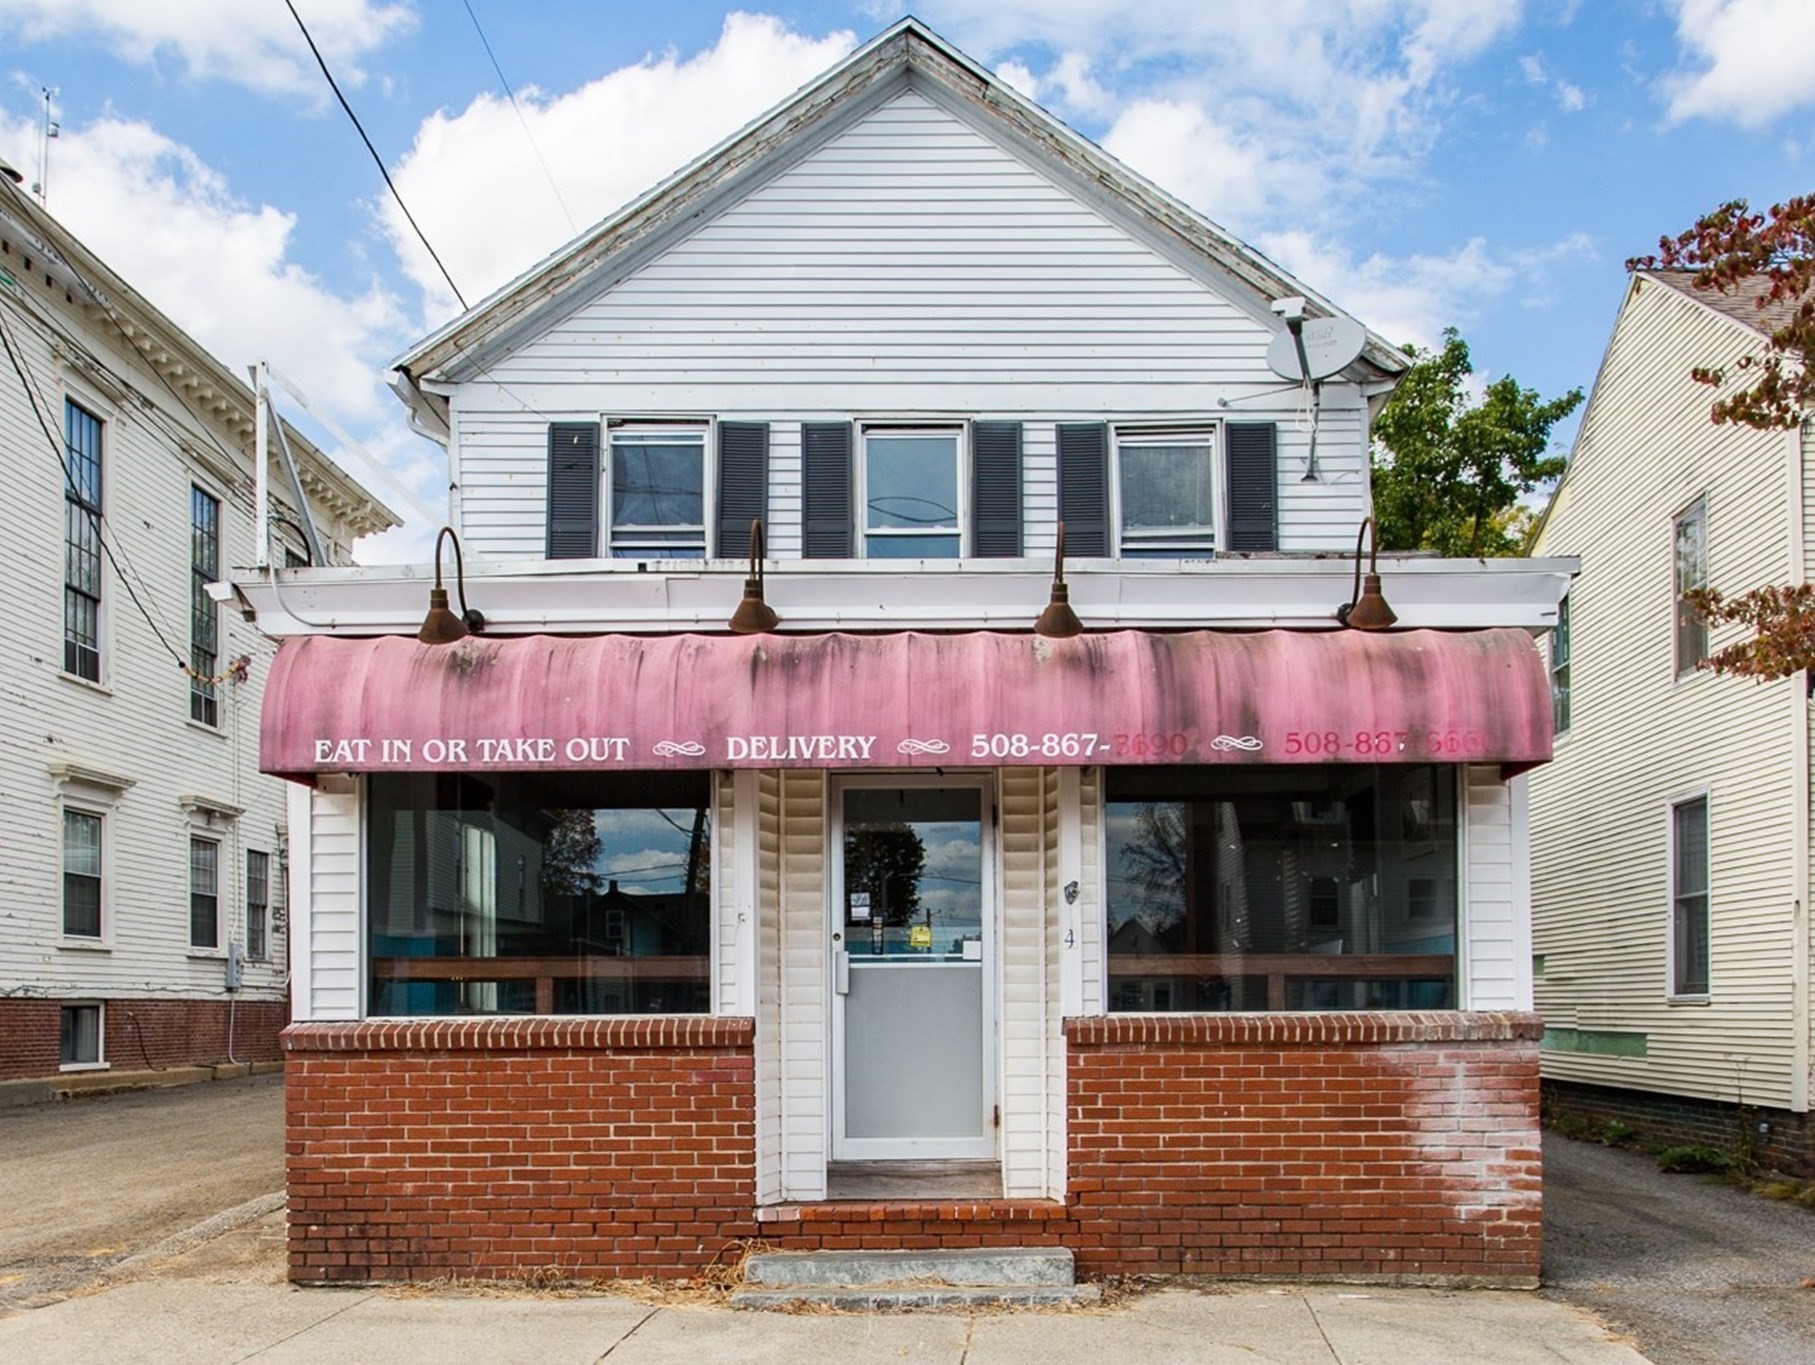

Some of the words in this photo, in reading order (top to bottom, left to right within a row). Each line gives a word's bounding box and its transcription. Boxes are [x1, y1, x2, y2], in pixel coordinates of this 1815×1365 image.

[313, 739, 371, 763] EAT
[381, 739, 412, 763] IN
[422, 738, 468, 763] OR
[476, 738, 557, 762] TAKE
[565, 737, 630, 762] OUT
[726, 735, 876, 760] DELIVERY
[1064, 928, 1075, 949] 4
